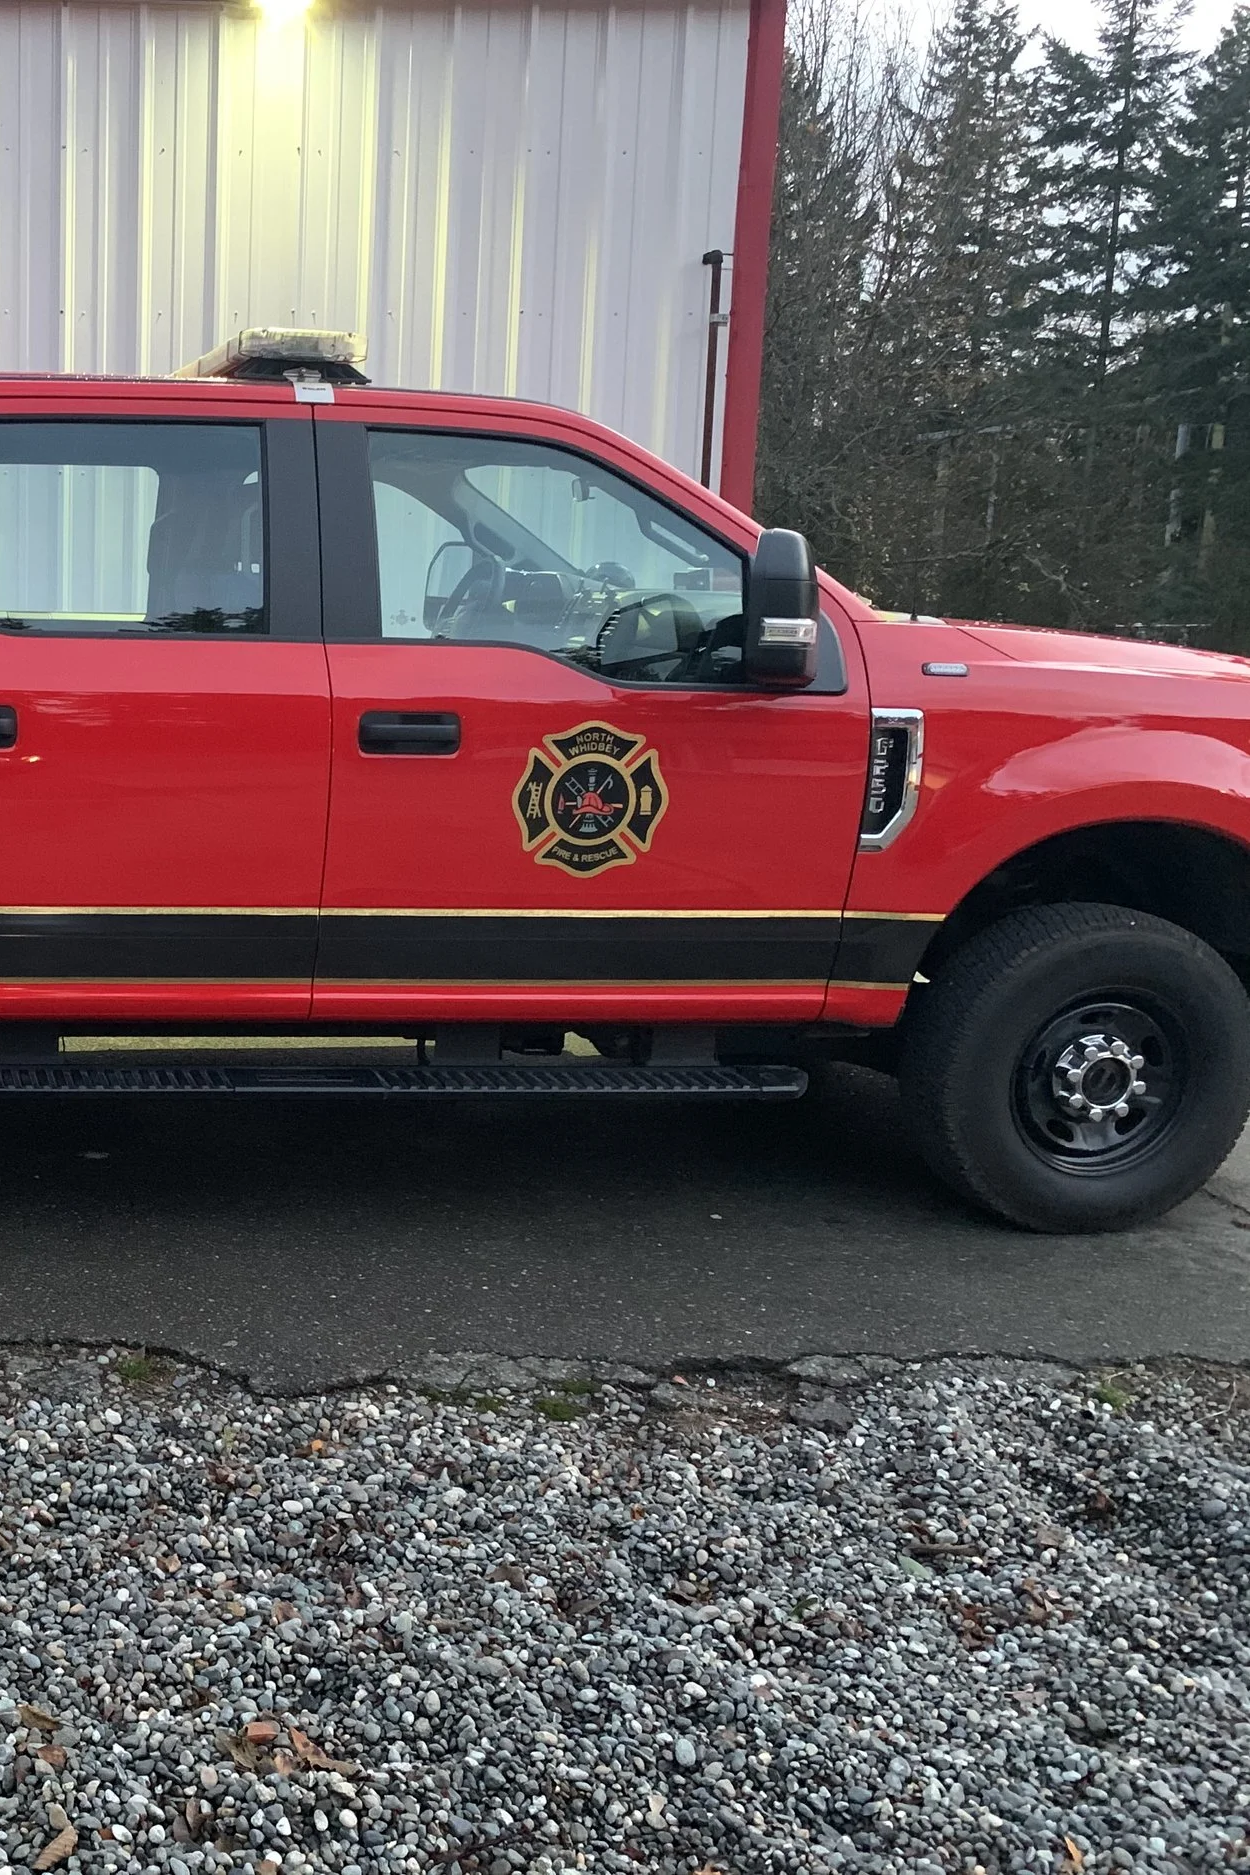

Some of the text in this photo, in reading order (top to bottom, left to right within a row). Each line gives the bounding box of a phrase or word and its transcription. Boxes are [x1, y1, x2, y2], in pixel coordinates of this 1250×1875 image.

[575, 732, 614, 744] NORTH
[568, 741, 620, 755] WHIDBEY
[551, 846, 619, 862] FIRE & RESCUE
